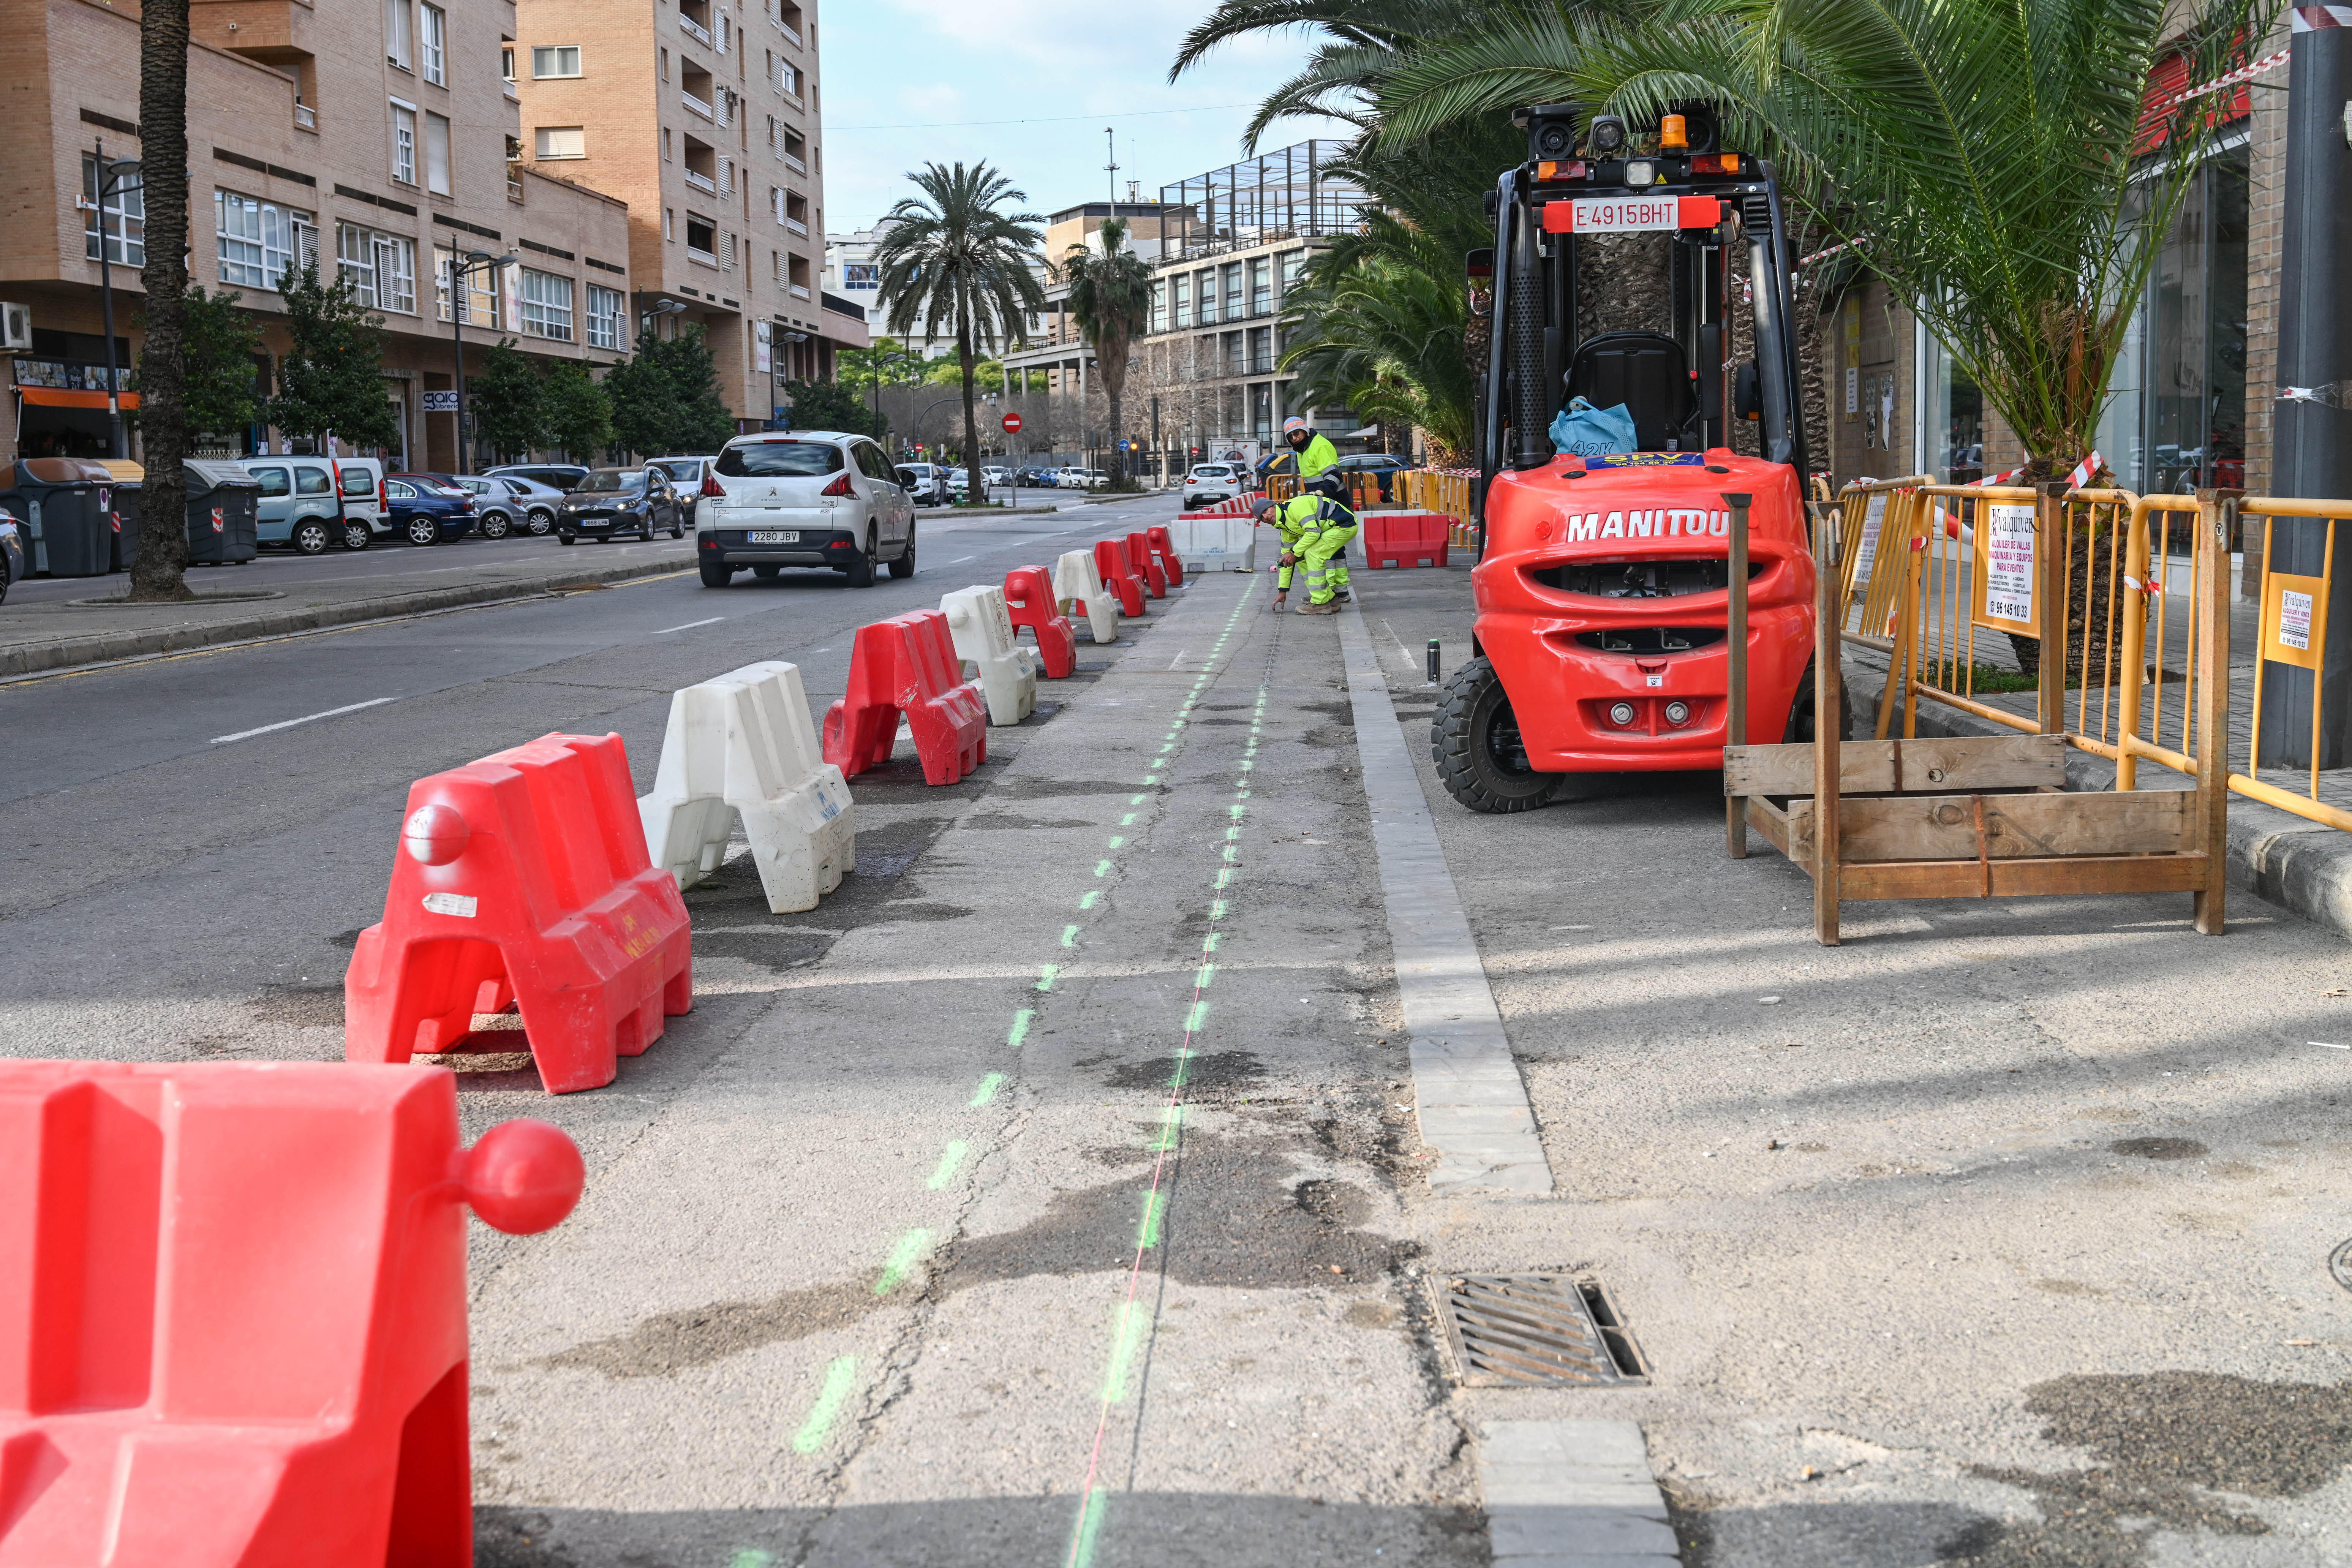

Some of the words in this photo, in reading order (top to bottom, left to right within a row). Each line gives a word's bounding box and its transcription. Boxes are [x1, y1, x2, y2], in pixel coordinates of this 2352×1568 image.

[423, 392, 458, 409] gaia
[1571, 441, 1614, 456] 42K
[1567, 508, 1729, 542] MANITOU
[1998, 509, 2033, 539] valquiven
[754, 533, 777, 541] 2280
[780, 533, 797, 541] JBV
[1992, 540, 2010, 549] ALQUILER
[2011, 541, 2015, 549] DE
[2017, 541, 2031, 550] VALLAS
[1989, 550, 2012, 560] MAQUINARIA
[2013, 553, 2016, 561] Y
[2016, 553, 2033, 563] EQUIPOS
[1996, 563, 2006, 572] PARA
[2007, 563, 2024, 574] EVENTOS
[1996, 602, 2003, 614] 96
[2004, 603, 2013, 615] 145
[2014, 604, 2020, 616] 10
[2021, 605, 2027, 618] 33
[2289, 595, 2311, 610] valquiven
